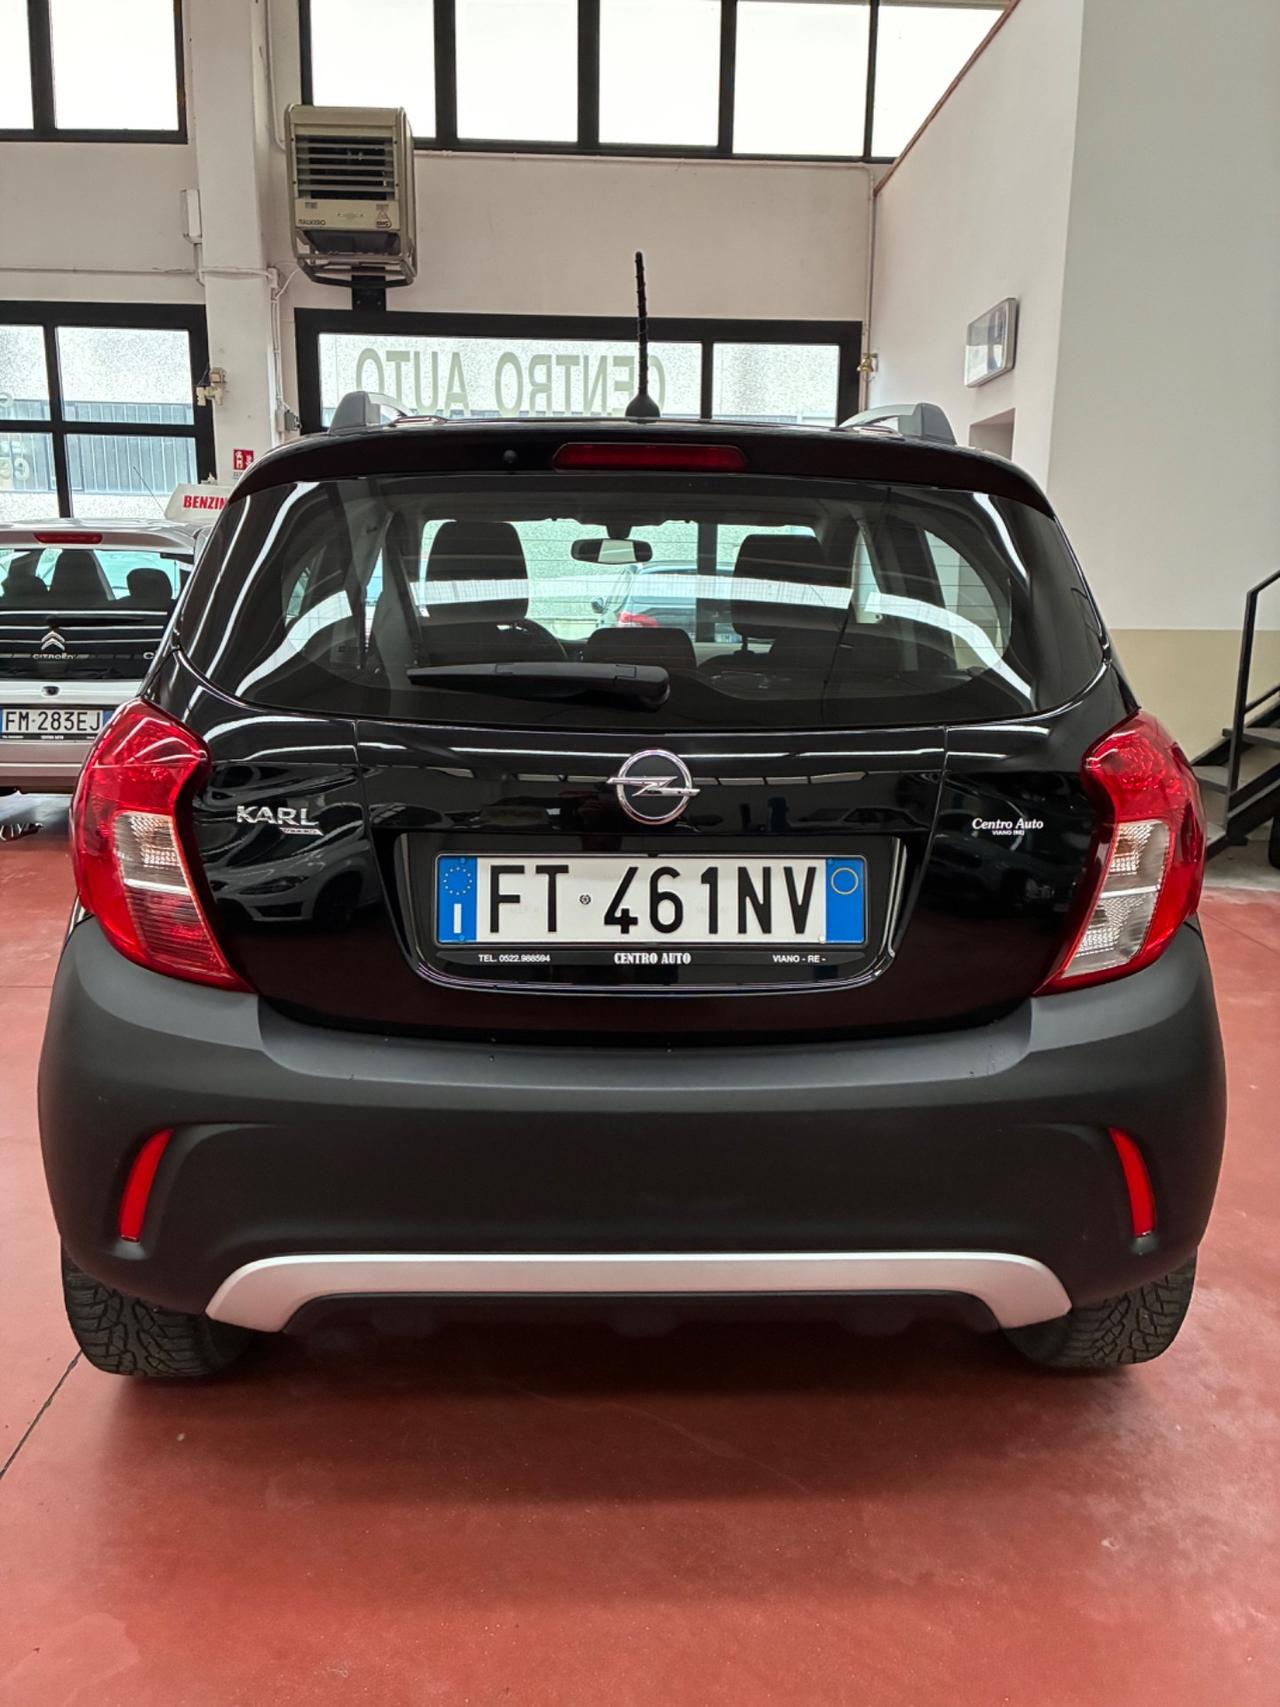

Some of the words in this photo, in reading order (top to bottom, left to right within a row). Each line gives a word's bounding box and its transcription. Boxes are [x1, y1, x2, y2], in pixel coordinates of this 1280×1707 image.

[183, 495, 227, 510] BENZIN
[5, 711, 30, 732] FM
[37, 711, 101, 732] 283EJ
[236, 805, 319, 826] KARL
[972, 817, 1013, 830] Centro
[1014, 817, 1044, 830] Auto
[490, 864, 570, 934] FT
[603, 866, 817, 935] 461NV
[453, 903, 462, 934] I
[478, 953, 497, 963] TEL.
[613, 952, 658, 965] CENTRO
[661, 952, 692, 965] AUTO
[772, 954, 800, 964] VIANO
[807, 954, 821, 964] RE
